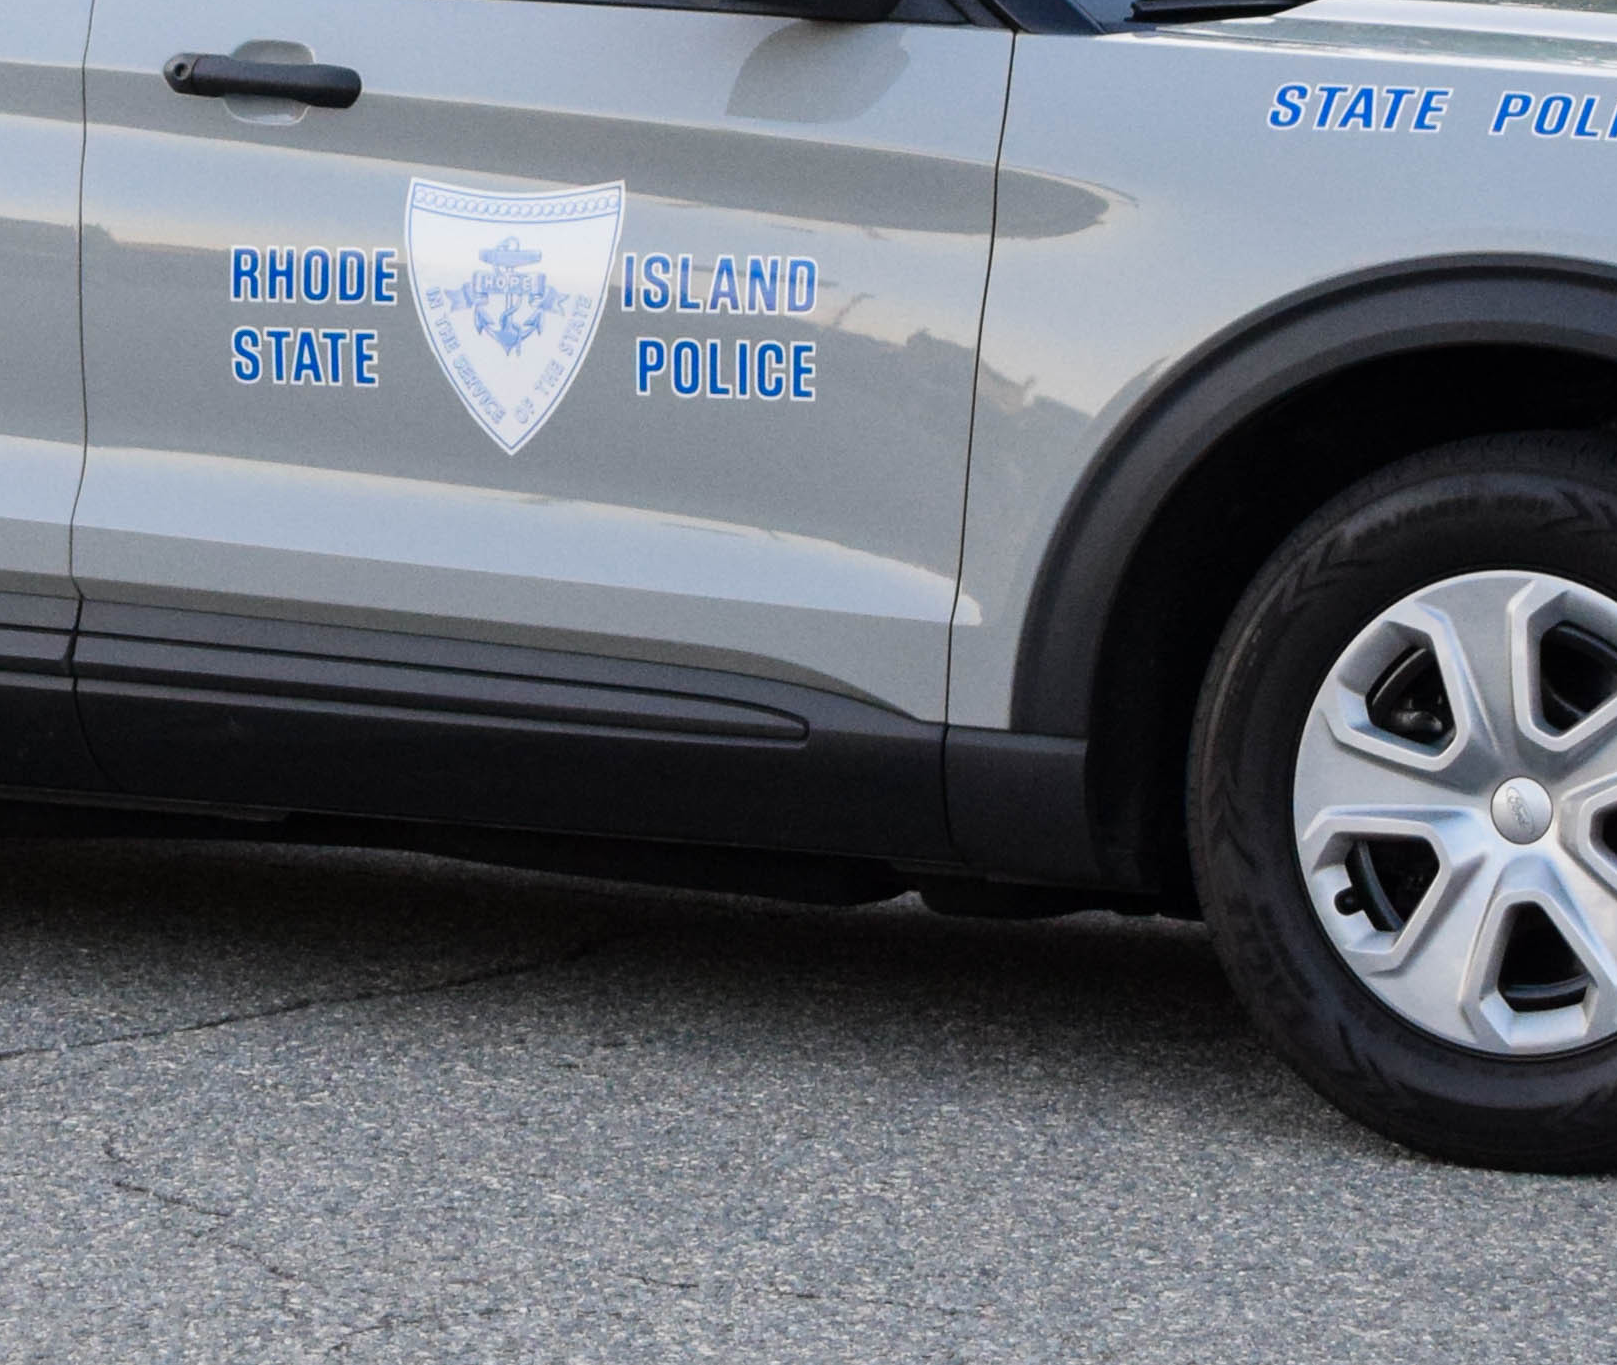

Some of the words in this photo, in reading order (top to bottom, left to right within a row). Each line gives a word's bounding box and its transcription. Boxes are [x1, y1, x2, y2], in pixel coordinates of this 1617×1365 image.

[1267, 82, 1453, 133] STATE
[230, 244, 398, 305] RHODE
[620, 251, 818, 316] ISLAND
[485, 276, 532, 291] HOPE
[231, 326, 379, 388] STATE
[635, 337, 817, 402] POLICE
[426, 287, 444, 309] IN
[435, 314, 461, 354] THE
[453, 355, 506, 424] SERVICE
[535, 360, 565, 396] THE
[559, 294, 592, 357] STATE
